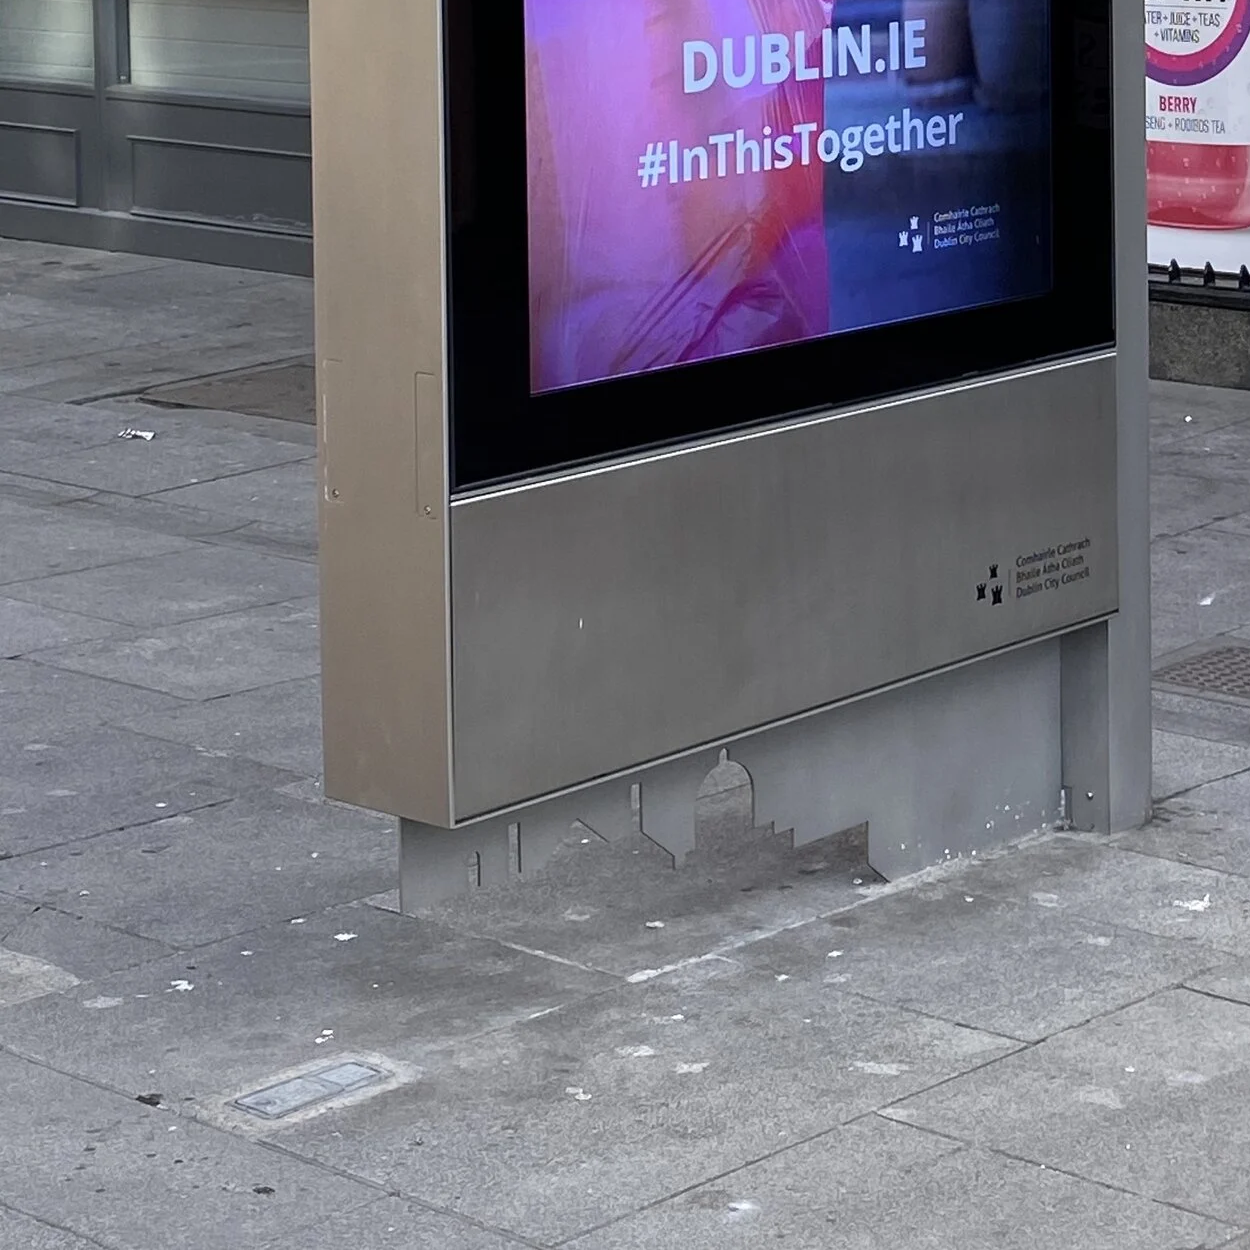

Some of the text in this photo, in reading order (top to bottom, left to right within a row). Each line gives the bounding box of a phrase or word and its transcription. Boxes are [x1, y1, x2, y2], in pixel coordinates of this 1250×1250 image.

[1198, 12, 1222, 28] TEAS
[683, 19, 927, 94] DUBLIN.IE
[1159, 95, 1198, 114] BERRY
[1211, 119, 1226, 135] TEA
[638, 108, 964, 188] #InThisTogether
[1016, 566, 1091, 598] Dublin City Council
